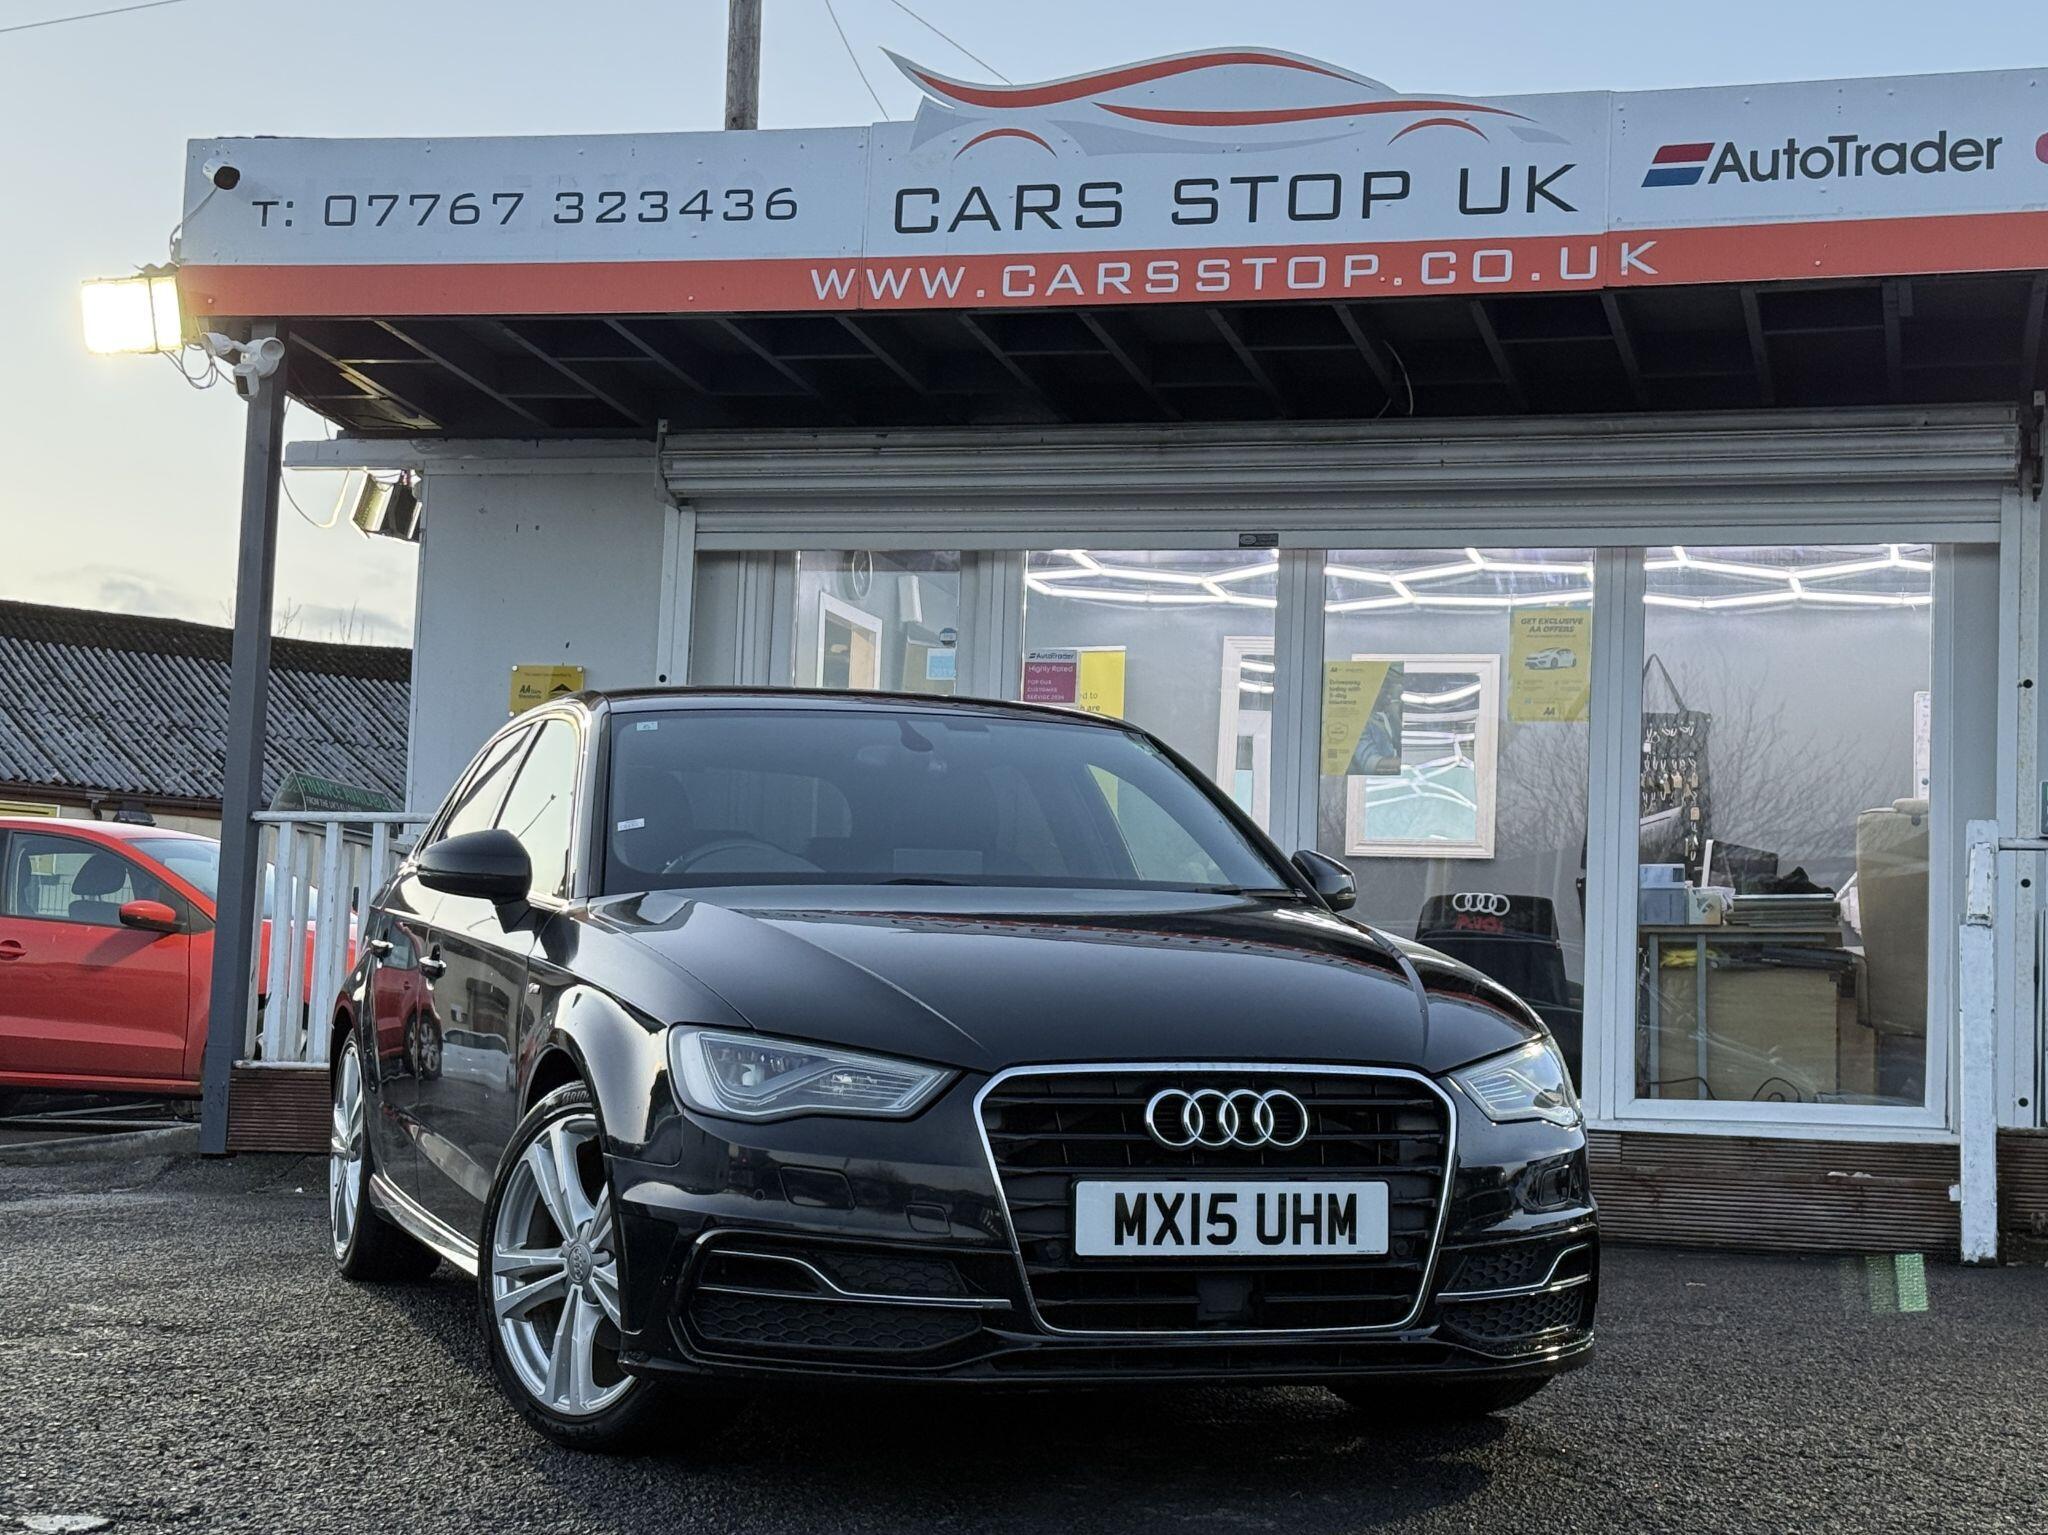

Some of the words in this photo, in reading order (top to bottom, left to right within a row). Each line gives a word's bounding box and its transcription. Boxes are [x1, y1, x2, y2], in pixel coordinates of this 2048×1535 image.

[1707, 130, 2003, 184] AutoTrader
[324, 193, 524, 227] 07767
[553, 187, 798, 224] 323436
[895, 182, 1123, 233] CARS
[1171, 171, 1411, 225] STOP
[1458, 164, 1579, 215] UK
[811, 241, 1658, 301] WWW.CARSSTOP.CO.UK
[1028, 665, 1050, 673] Highly
[1051, 665, 1073, 673] Rated
[1114, 1193, 1238, 1245] MX15
[1256, 1193, 1357, 1245] UHM
